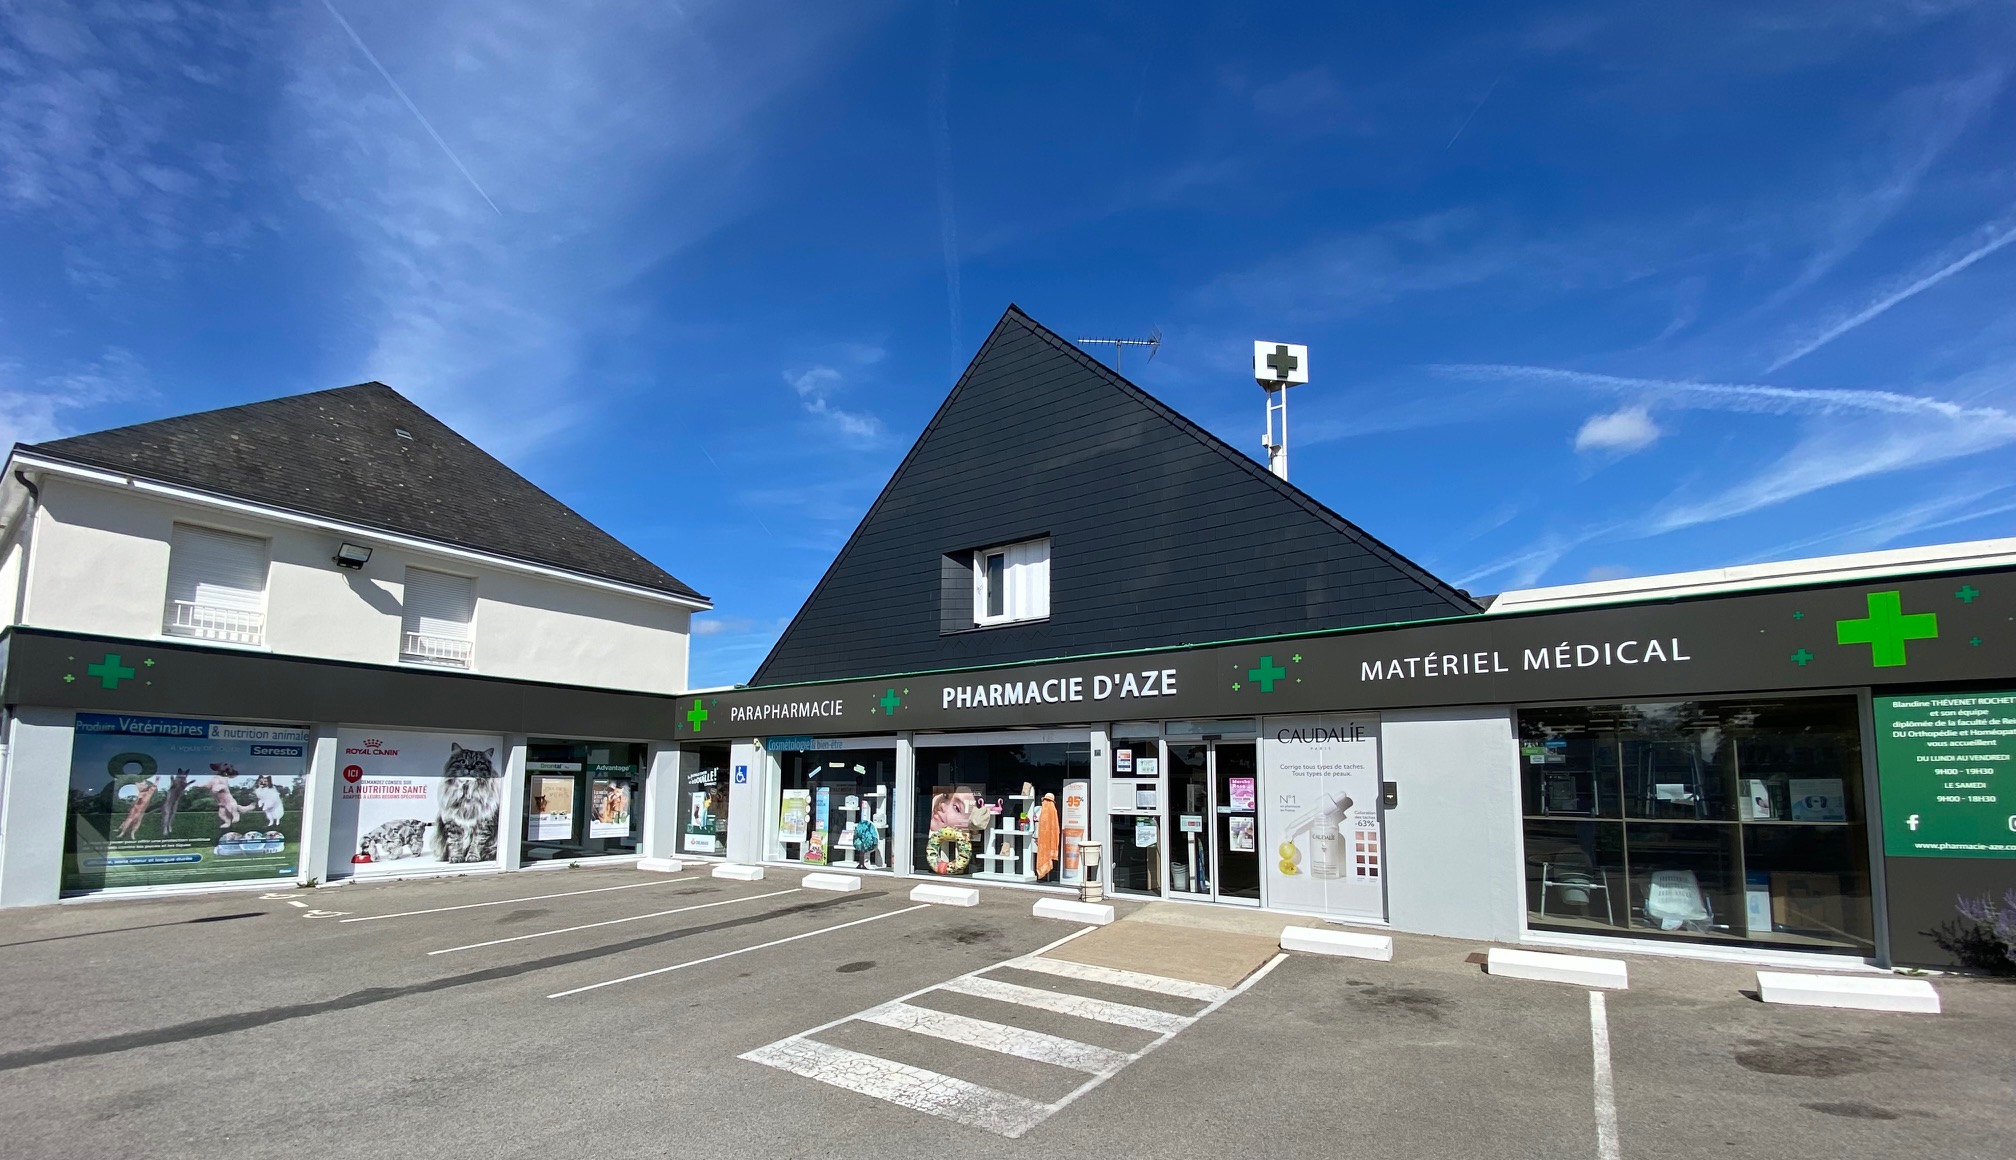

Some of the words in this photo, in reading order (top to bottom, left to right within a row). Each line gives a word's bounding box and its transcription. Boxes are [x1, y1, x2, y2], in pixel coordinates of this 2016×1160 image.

[1361, 652, 1509, 682] MATÉRIEL
[1523, 637, 1691, 671] MÉDICAL
[942, 678, 1083, 709] PHARMACIE
[1094, 669, 1177, 700] D'AZE
[730, 700, 843, 722] PARAPHARMACIE
[1957, 709, 1989, 717] équipe
[1892, 720, 1933, 729] diplômée
[1957, 718, 1987, 726] faculté
[119, 717, 203, 736] Vétérinaires
[211, 726, 220, 737] &
[223, 727, 268, 739] nutrition
[272, 728, 309, 742] animale
[1908, 730, 1958, 739] Orthopédie
[768, 739, 810, 751] Cosmétologie
[1949, 739, 1997, 747] accueillent
[253, 746, 299, 756] Seresto
[348, 769, 358, 778] ICI
[596, 764, 630, 773] Advantage
[1966, 767, 1994, 775] 19H30
[343, 785, 354, 794] LA
[356, 785, 400, 794] NUTRITION
[402, 784, 428, 794] SANTÉ
